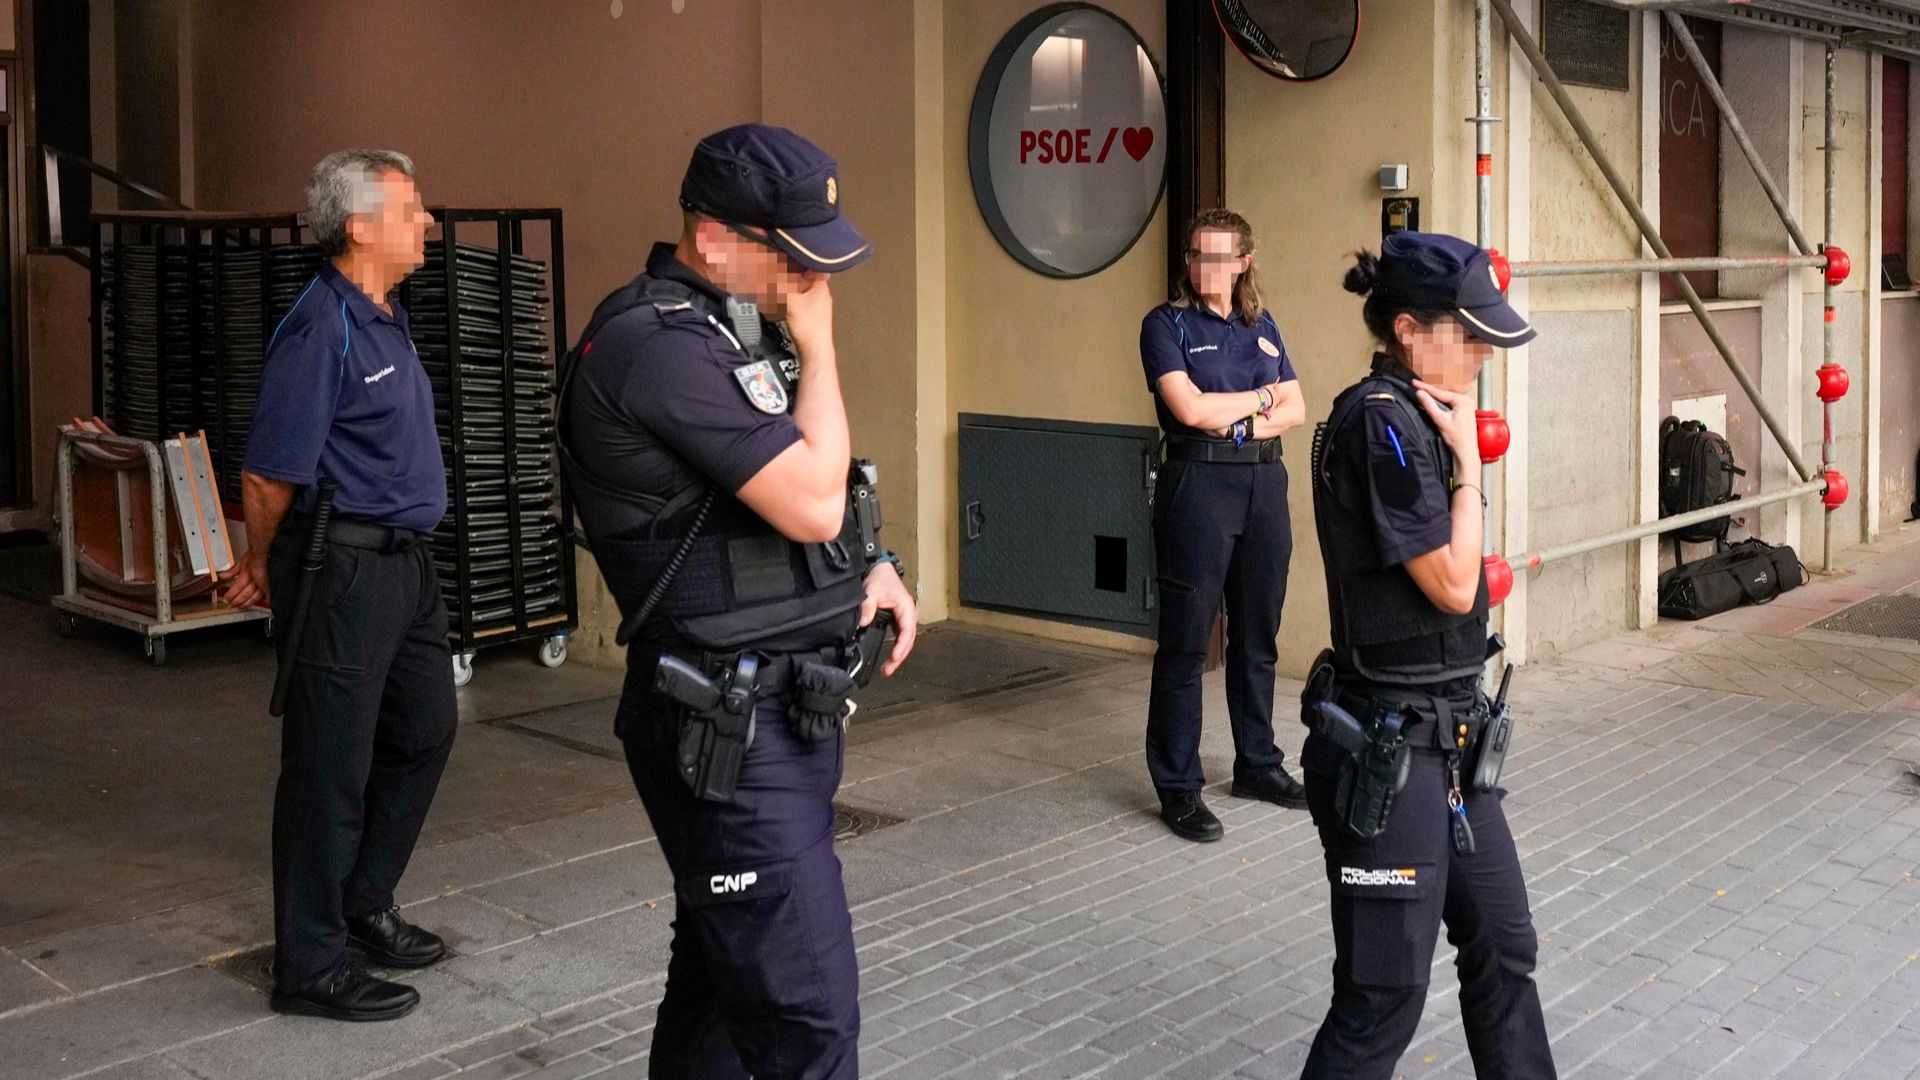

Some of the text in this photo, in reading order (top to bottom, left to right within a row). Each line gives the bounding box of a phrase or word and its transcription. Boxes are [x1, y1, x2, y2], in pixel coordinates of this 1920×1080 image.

[1020, 129, 1091, 164] PSOE
[710, 871, 758, 894] CNP
[1341, 875, 1416, 885] NACIONAL
